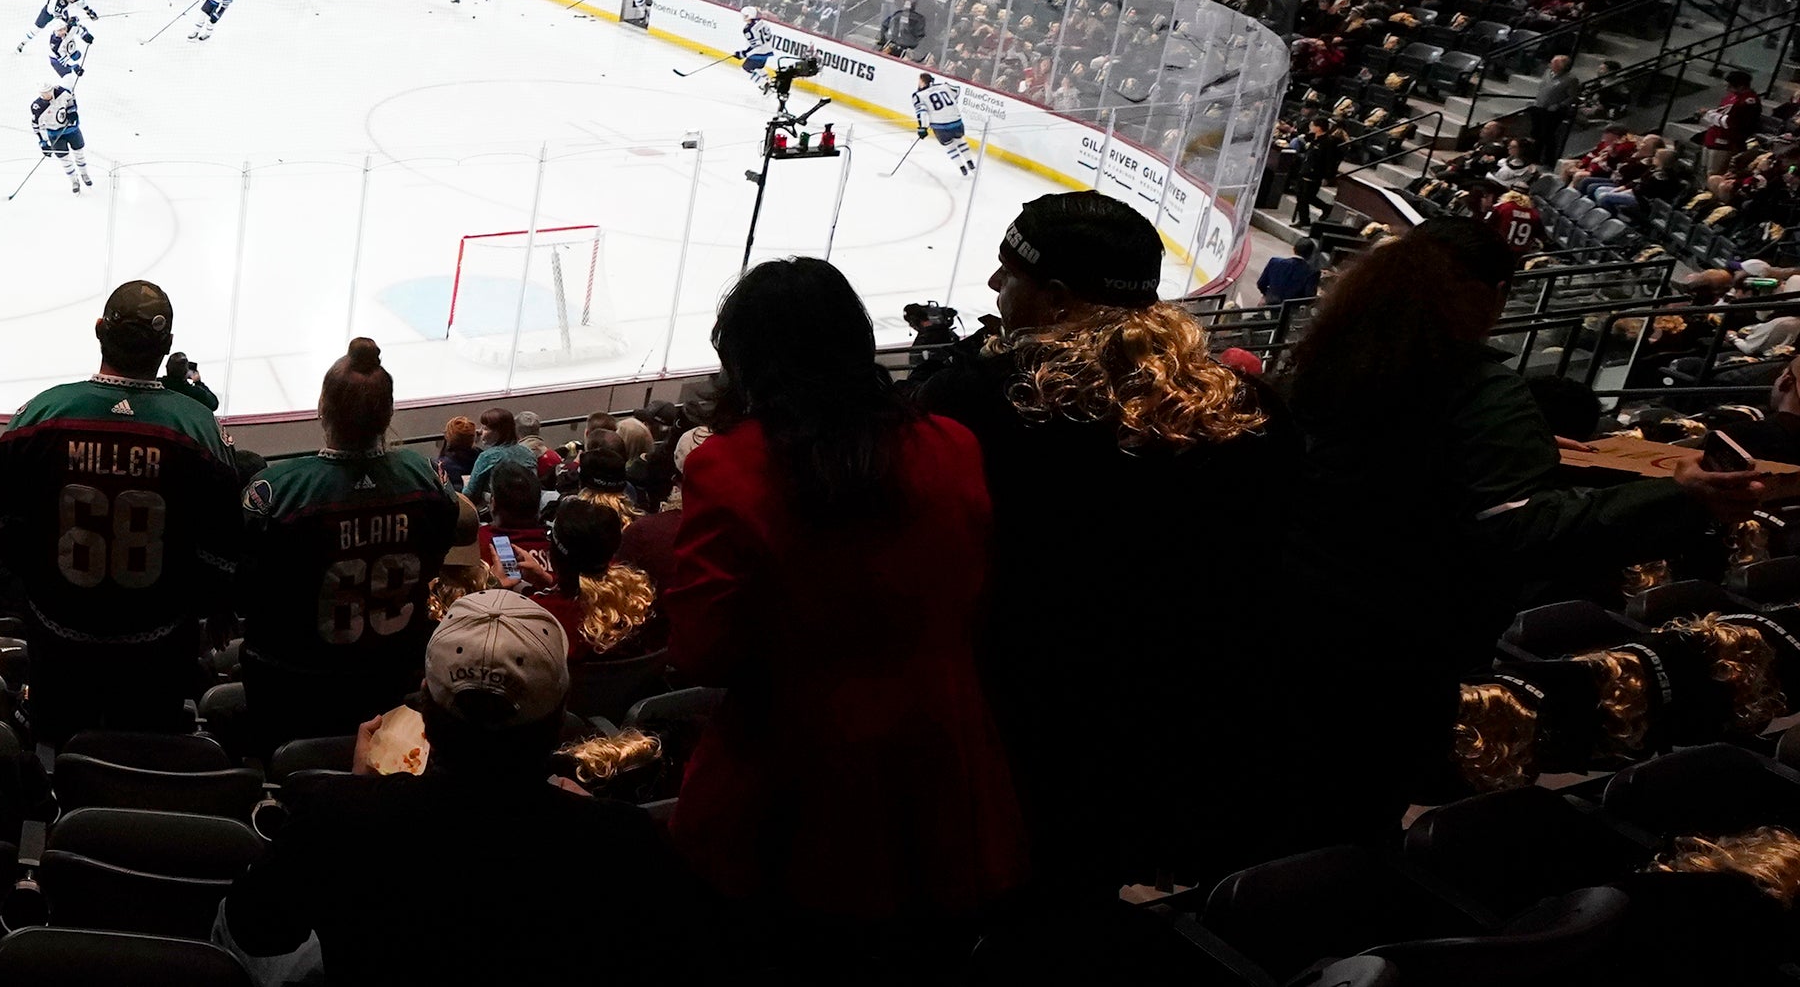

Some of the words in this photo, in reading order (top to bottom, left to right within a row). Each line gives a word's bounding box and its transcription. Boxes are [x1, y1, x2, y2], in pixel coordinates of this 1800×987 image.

[652, 2, 679, 17] hoenix
[679, 9, 718, 30] Children's
[929, 91, 954, 111] 80
[962, 97, 1007, 120] BlueShield
[964, 87, 1005, 108] BlueCross
[1109, 149, 1139, 172] RIVER
[1142, 167, 1164, 189] GILA
[1507, 220, 1532, 246] 19
[1016, 240, 1041, 265] GO
[1103, 277, 1138, 291] YOU
[1141, 278, 1158, 290] DO
[68, 440, 162, 478] MILLER
[57, 483, 167, 590] 68
[338, 512, 410, 551] BLAIR
[449, 667, 474, 682] LOS
